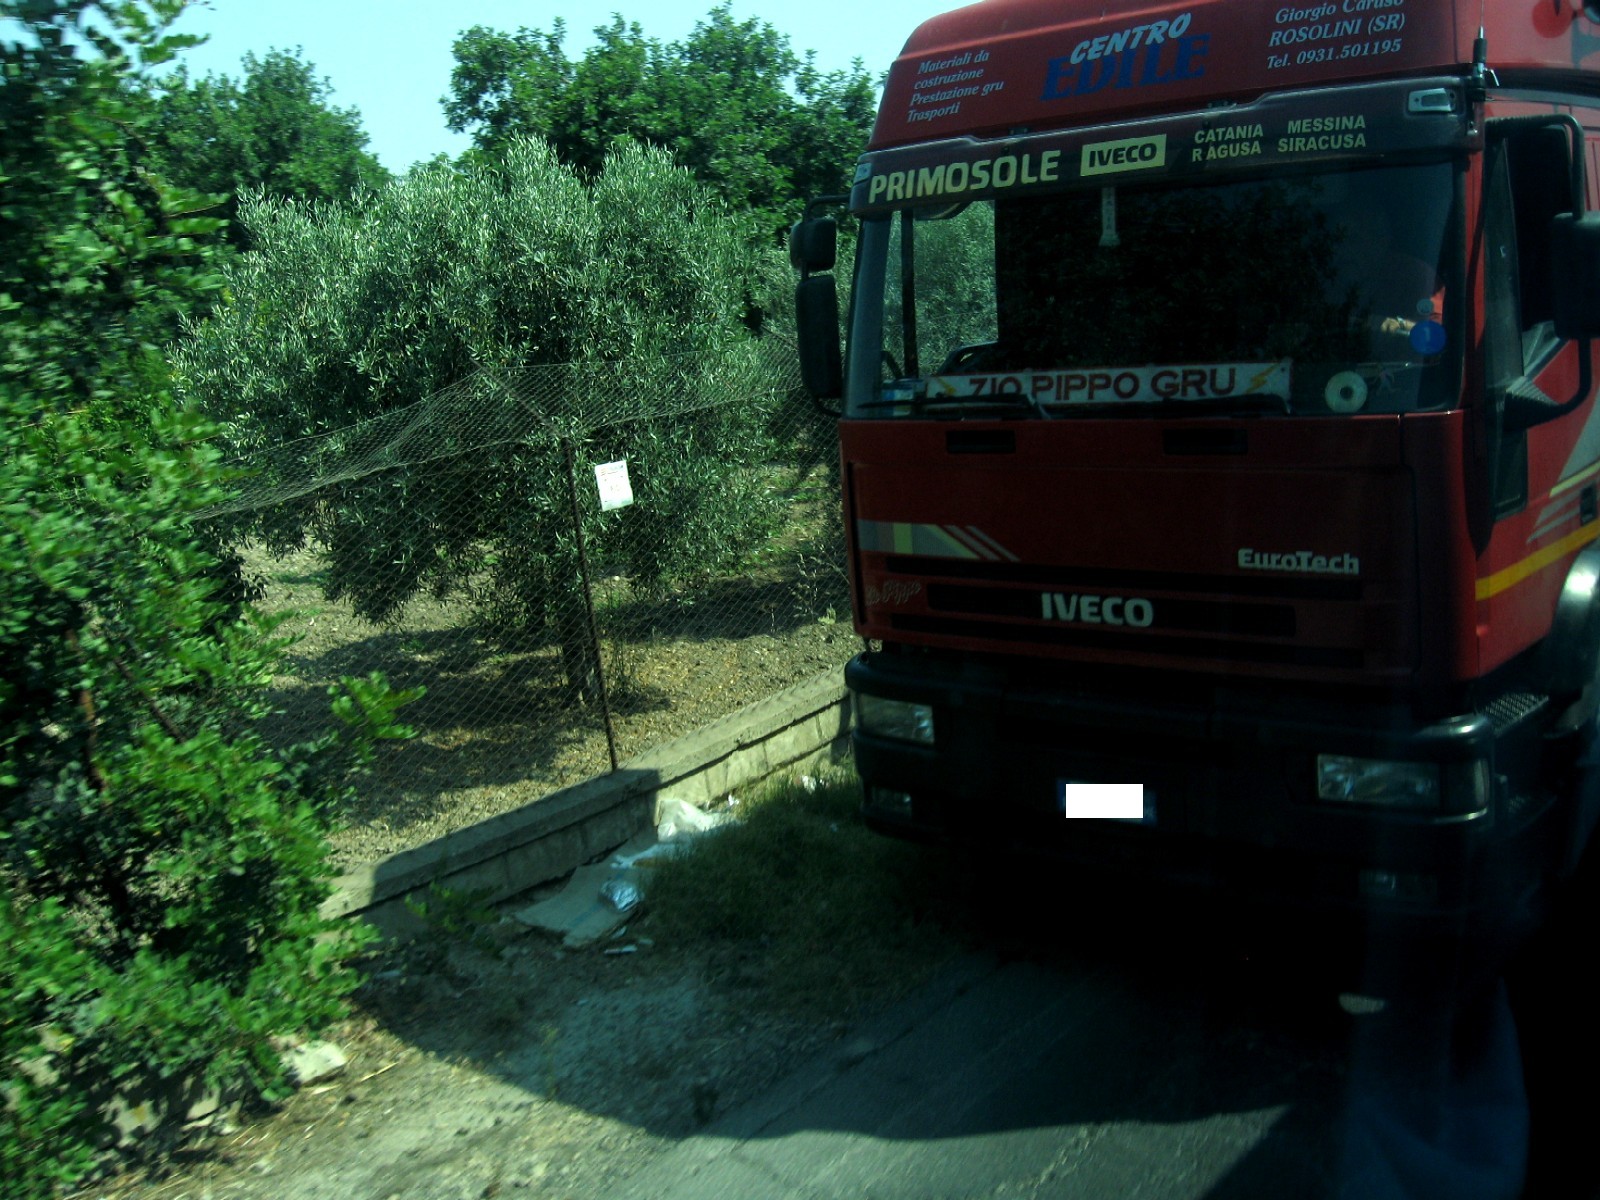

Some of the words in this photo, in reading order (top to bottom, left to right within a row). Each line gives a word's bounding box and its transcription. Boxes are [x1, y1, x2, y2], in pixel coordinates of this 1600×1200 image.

[1275, 2, 1337, 25] Giorgio
[1069, 12, 1192, 65] CENTRO
[1268, 18, 1361, 48] ROSOLINI
[1367, 12, 1406, 37] (SR)
[917, 52, 972, 75] Materiali
[974, 49, 990, 64] da
[1039, 33, 1211, 101] EDILE
[1267, 53, 1291, 70] Tel.
[1296, 38, 1402, 65] 0931.501195
[914, 68, 984, 90] costruzione
[909, 85, 980, 107] Prestazione
[981, 81, 1005, 97] gru
[907, 101, 961, 123] Trasporti
[1287, 114, 1366, 135] MESSINA
[1194, 123, 1264, 145] CATANIA
[1278, 132, 1366, 154] SIRACUSA
[1089, 142, 1158, 168] IVECO
[868, 150, 1062, 204] PRIMOSOLE
[969, 376, 1022, 397] ZIO
[1031, 370, 1139, 400] PIPPO
[1151, 367, 1236, 397] GRU
[1237, 547, 1360, 575] EuroTech
[1040, 591, 1155, 628] IVECO
